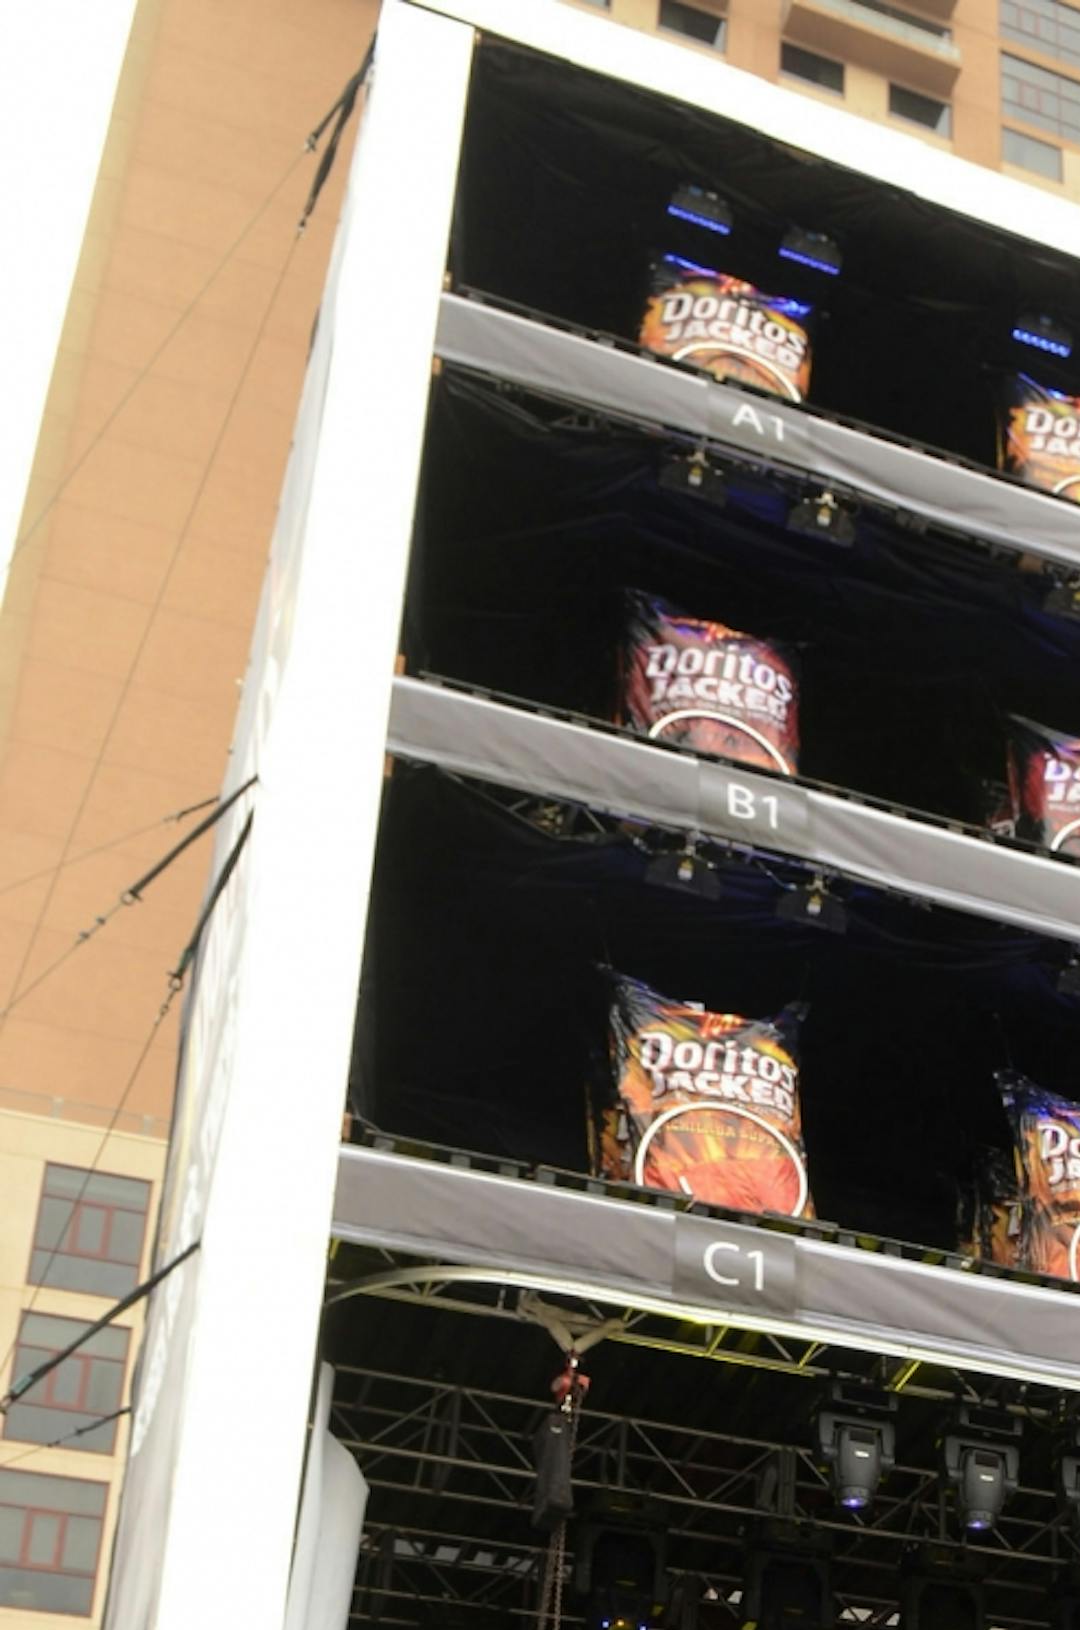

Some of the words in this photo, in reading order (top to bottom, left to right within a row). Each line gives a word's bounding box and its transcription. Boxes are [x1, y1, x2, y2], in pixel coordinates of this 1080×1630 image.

[662, 292, 807, 356] Doritos
[664, 319, 801, 371] JACKED
[732, 403, 785, 441] A1
[646, 644, 793, 702] Doritos
[652, 674, 787, 722] JACKED
[727, 781, 781, 829] B1
[639, 1031, 797, 1092] Doritos
[651, 1070, 794, 1117] JACKED
[703, 1240, 766, 1291] C1
